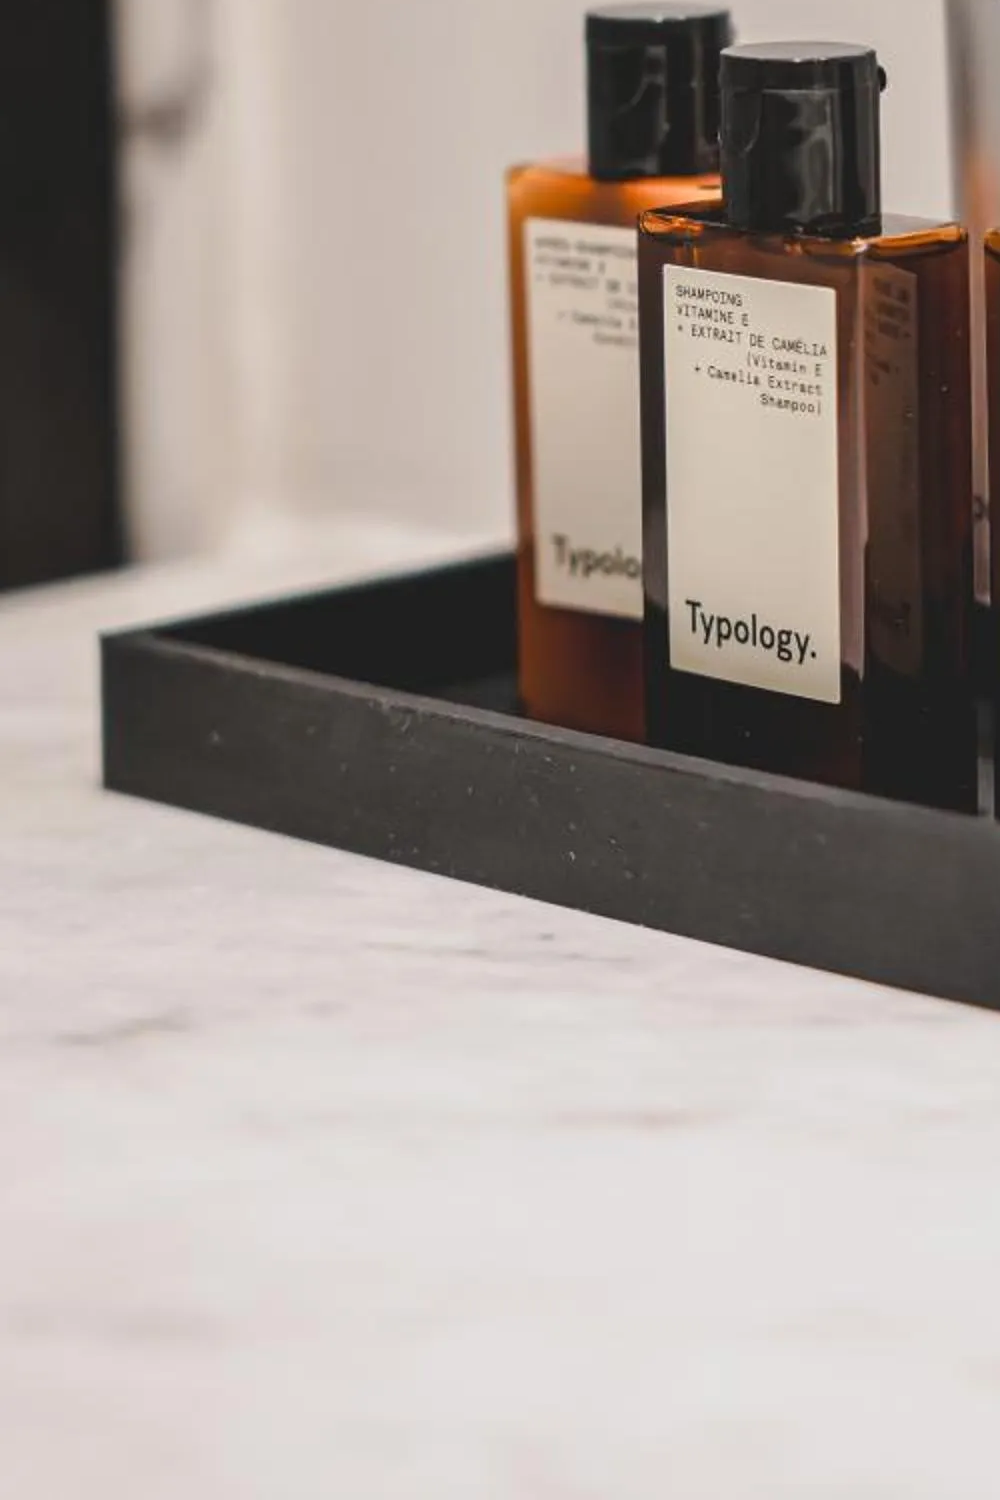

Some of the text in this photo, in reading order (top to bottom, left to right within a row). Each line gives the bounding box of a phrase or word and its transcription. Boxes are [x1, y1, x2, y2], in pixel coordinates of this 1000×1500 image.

[675, 285, 743, 307] SHAMPOING
[677, 305, 749, 327] VITAMINE E
[691, 324, 743, 344] EXTRAIT
[749, 333, 765, 348] DE
[772, 334, 828, 357] CAMÉLIA
[747, 351, 824, 377] (Vitamin E
[707, 366, 761, 386] Camelia
[768, 375, 824, 396] Extract
[760, 393, 822, 416] Shampoo)
[686, 600, 817, 666] Typology.
